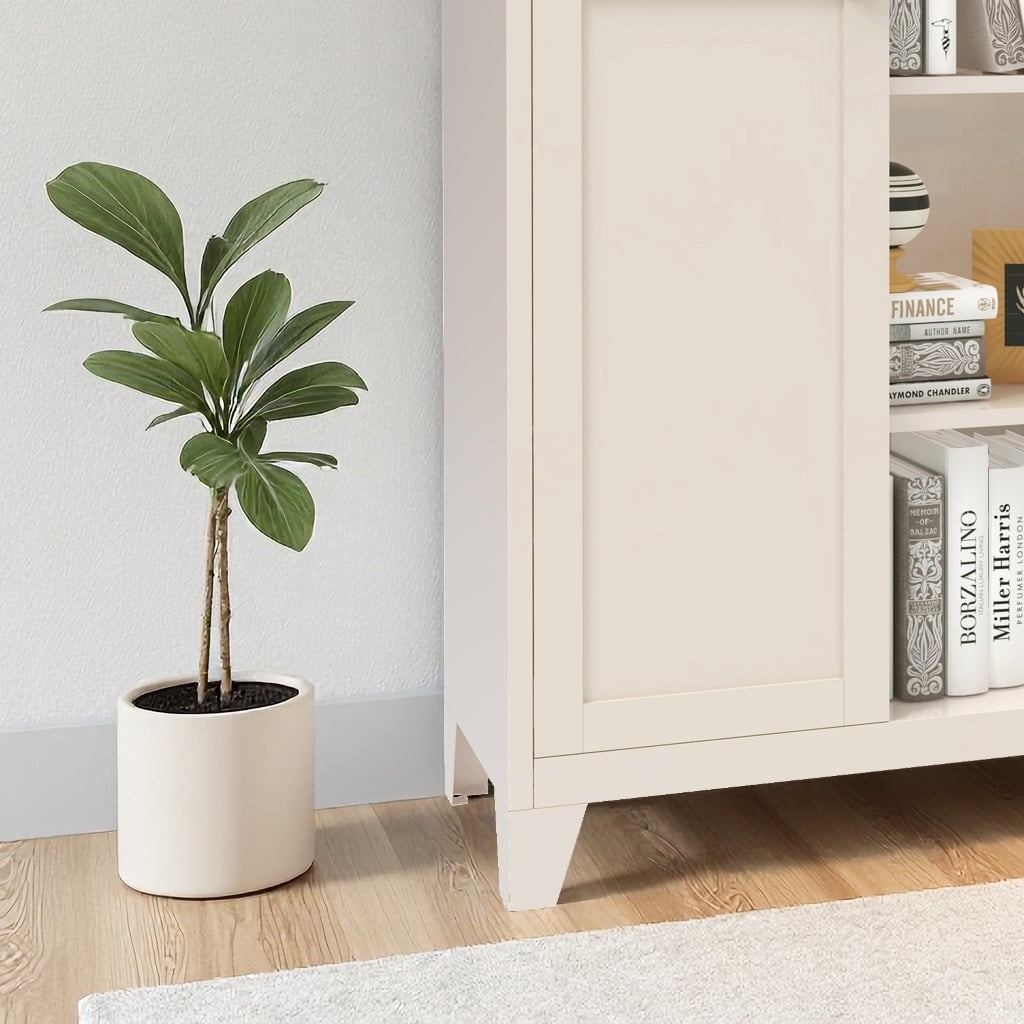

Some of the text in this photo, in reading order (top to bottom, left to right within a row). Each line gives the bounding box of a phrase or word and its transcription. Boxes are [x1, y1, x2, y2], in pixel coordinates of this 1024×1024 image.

[891, 298, 955, 319] FINANCE
[924, 326, 970, 336] AUTHOR NAME
[926, 386, 970, 397] CHANDLER
[909, 508, 939, 516] MEMOIR
[909, 528, 938, 536] BALZAC
[960, 510, 977, 646] BORZALINO
[993, 503, 1010, 642] Miller Harris
